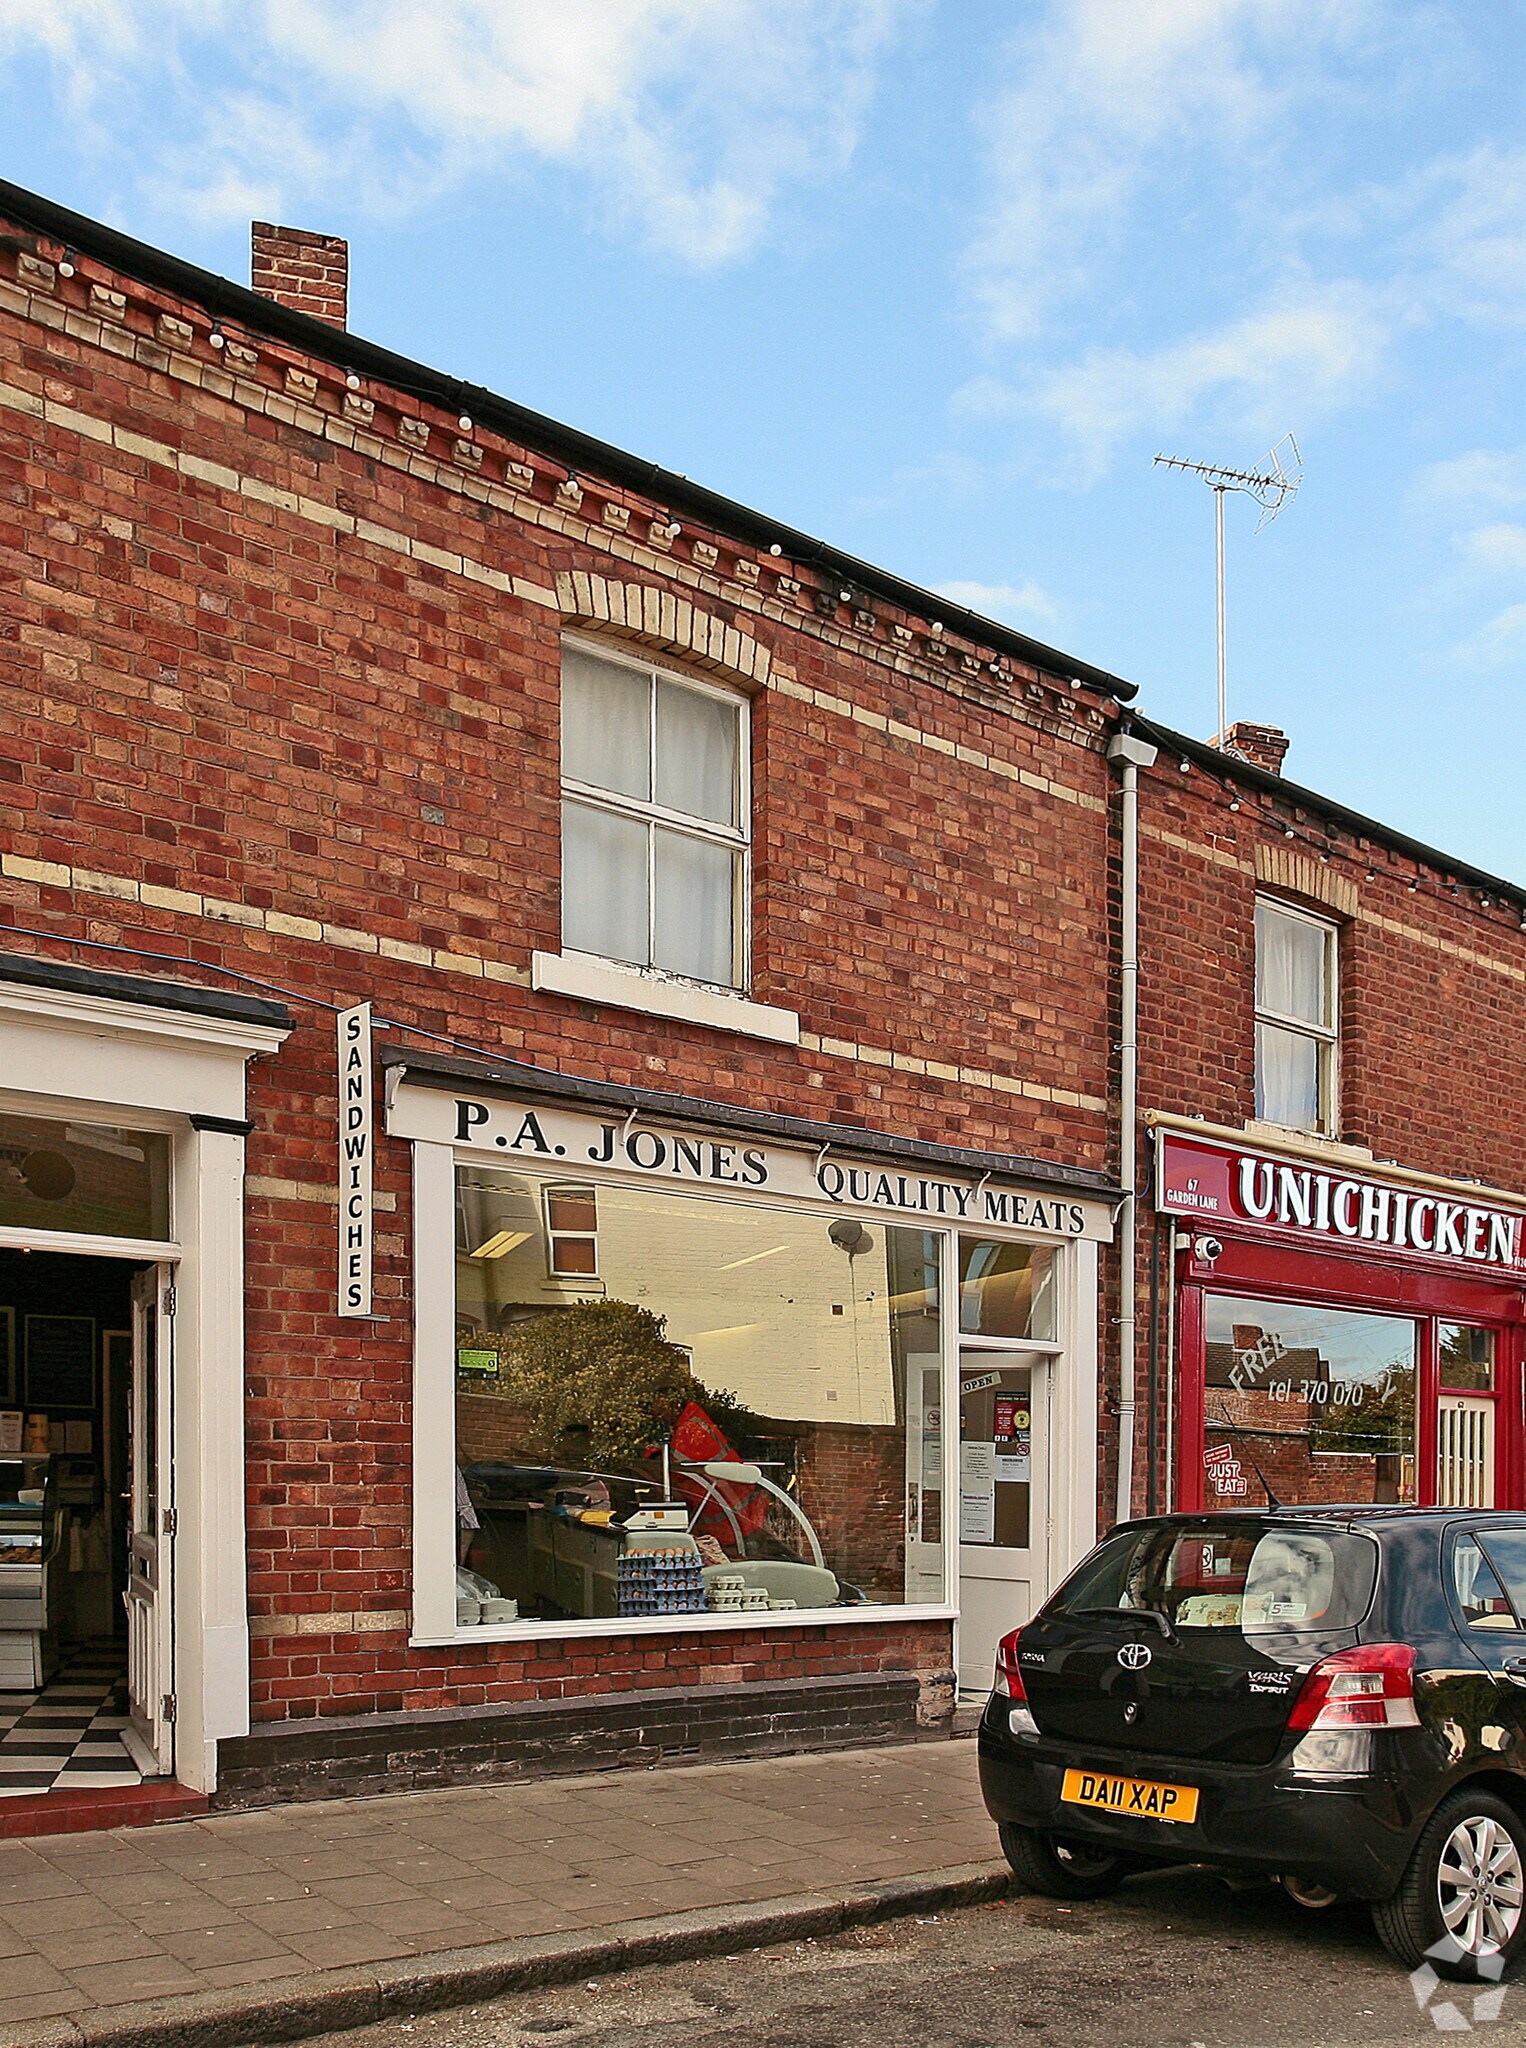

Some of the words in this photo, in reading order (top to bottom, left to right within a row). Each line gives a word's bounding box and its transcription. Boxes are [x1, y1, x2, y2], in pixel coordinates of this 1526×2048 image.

[453, 1099, 566, 1156] P.A.
[588, 1123, 769, 1185] JONES
[344, 1015, 367, 1307] SANDWICHES
[1187, 1178, 1199, 1192] 67
[817, 1162, 973, 1217] QUALITY
[984, 1191, 1085, 1234] MEATS
[1166, 1188, 1198, 1207] GARDEN
[1199, 1195, 1218, 1211] LANE
[1238, 1156, 1515, 1265] UNICHICKEN
[963, 1375, 993, 1391] OPEN
[1268, 1378, 1292, 1403] tel
[1297, 1379, 1329, 1405] 370
[1210, 1463, 1239, 1478] JUST
[1217, 1478, 1239, 1493] EAT
[1248, 1670, 1293, 1685] YARIS
[1079, 1775, 1125, 1807] DA11
[1128, 1783, 1178, 1814] XAP
